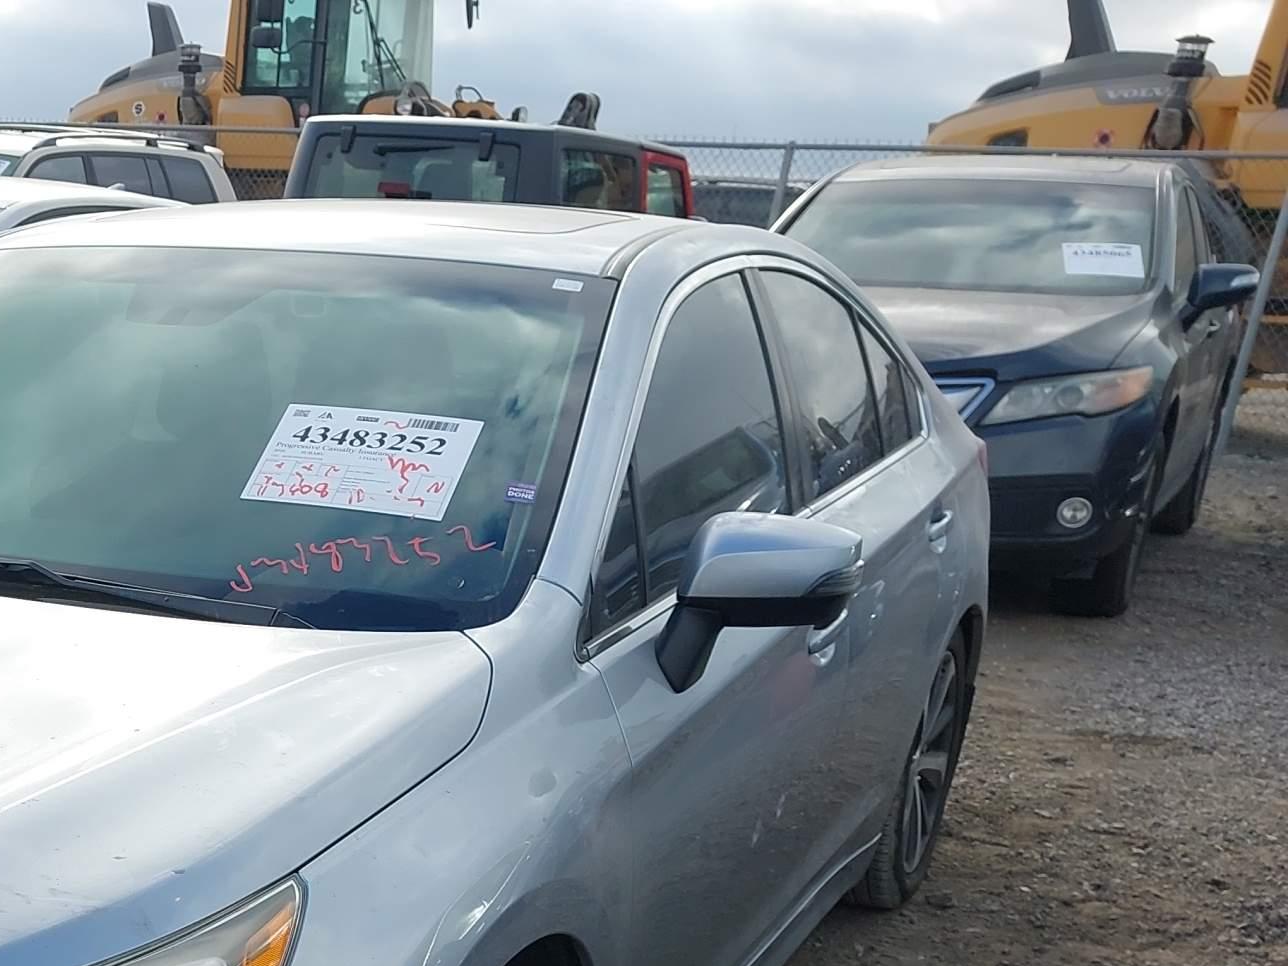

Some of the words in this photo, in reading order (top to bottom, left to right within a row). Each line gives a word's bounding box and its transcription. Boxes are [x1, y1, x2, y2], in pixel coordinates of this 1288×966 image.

[1105, 86, 1172, 99] VOLV
[292, 425, 447, 455] 43483252
[507, 490, 535, 500] DONE
